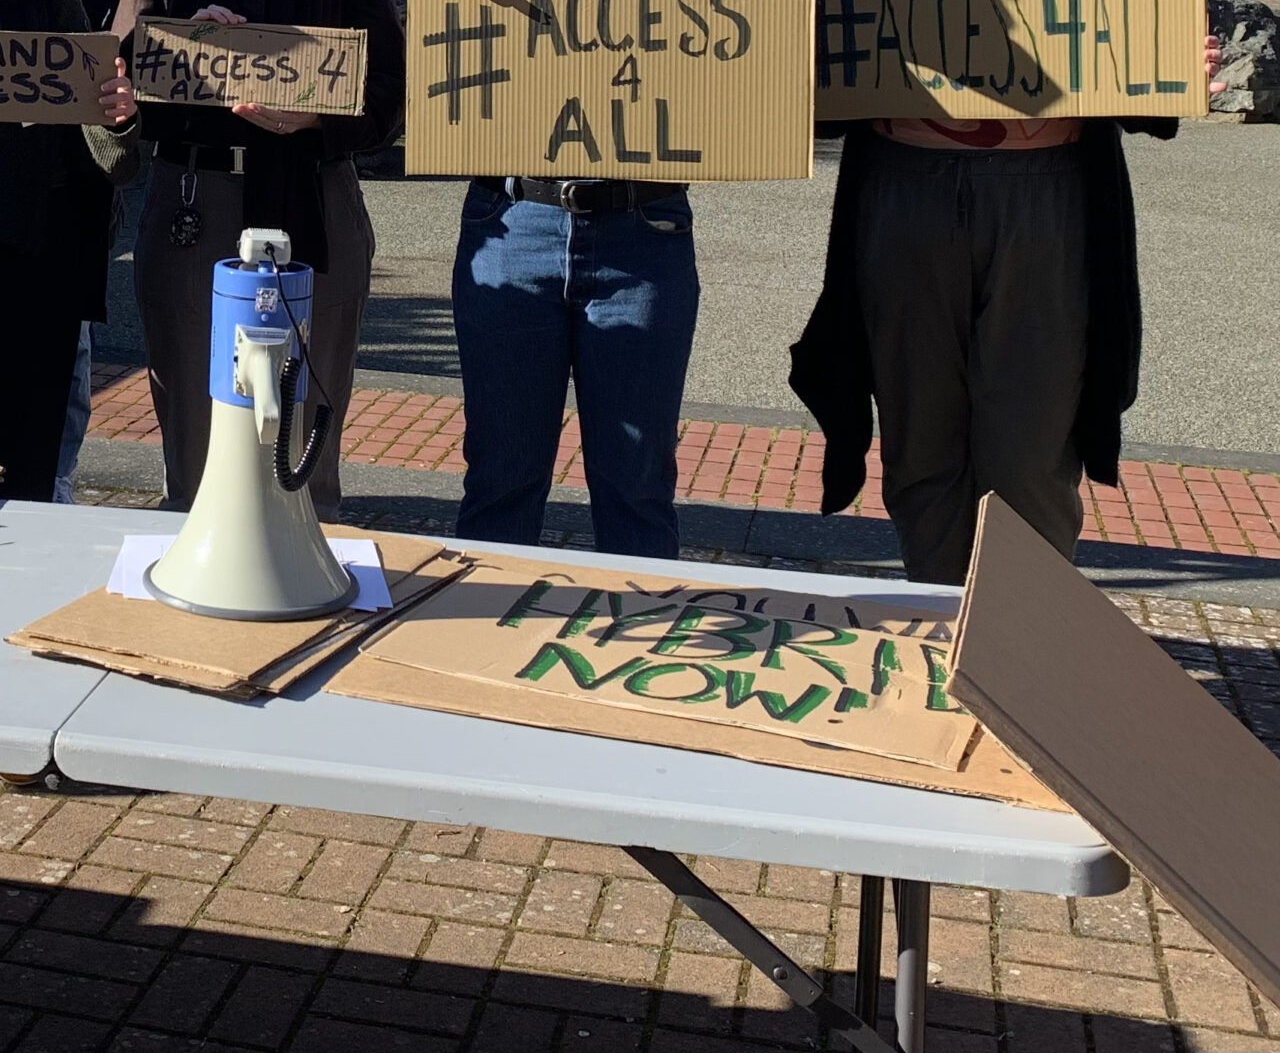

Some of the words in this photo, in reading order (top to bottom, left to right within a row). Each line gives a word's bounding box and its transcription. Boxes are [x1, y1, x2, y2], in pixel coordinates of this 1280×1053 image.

[170, 80, 239, 101] ALL
[318, 49, 347, 93] 4
[611, 53, 641, 102] 4
[544, 97, 702, 163] ALL
[515, 642, 869, 725] NOW!
